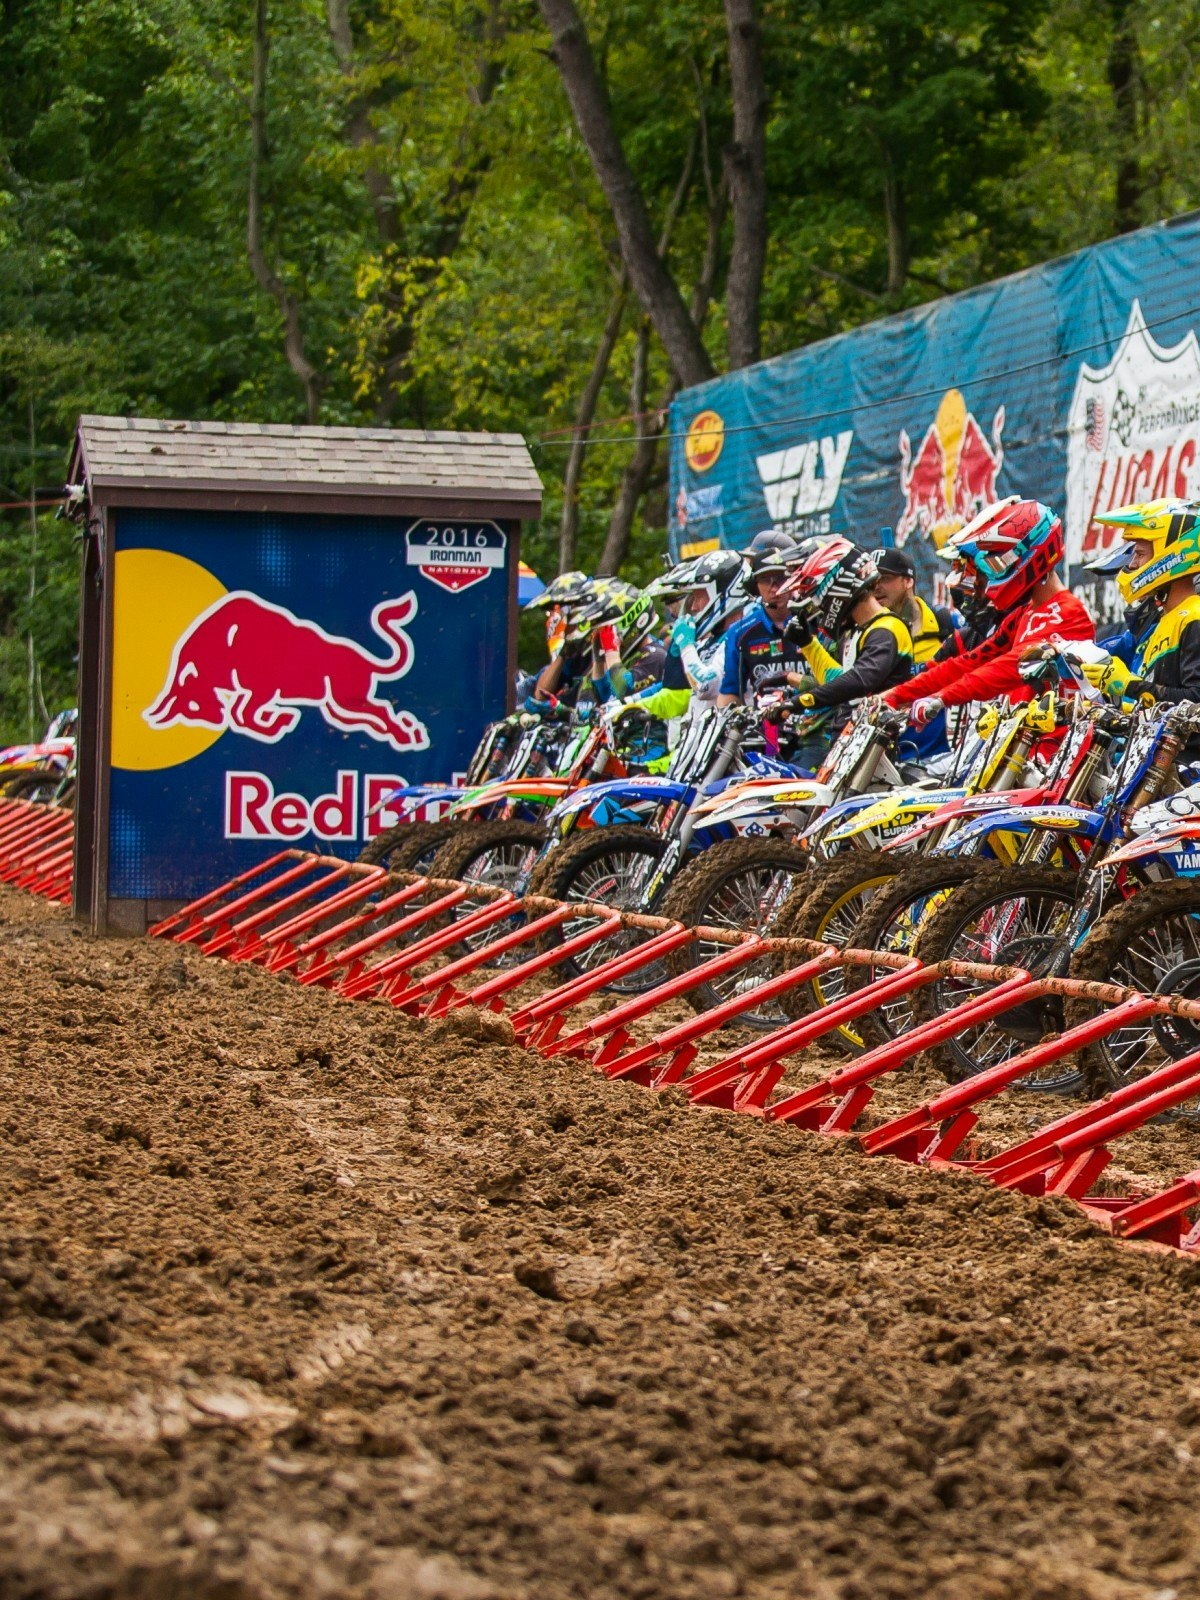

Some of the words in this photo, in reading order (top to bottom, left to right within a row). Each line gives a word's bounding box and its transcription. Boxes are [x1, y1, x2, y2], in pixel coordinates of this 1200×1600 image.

[1138, 402, 1200, 434] PERFORMANCE
[756, 429, 854, 521] FLY
[1082, 438, 1196, 552] LUCAS
[426, 527, 487, 547] 2016
[430, 550, 481, 562] IRONMAN
[428, 567, 483, 575] NATIONAL
[1130, 552, 1186, 594] SUPERSTORE!
[768, 660, 815, 677] YAMA
[225, 770, 358, 841] Red
[883, 826, 913, 838] SUPP
